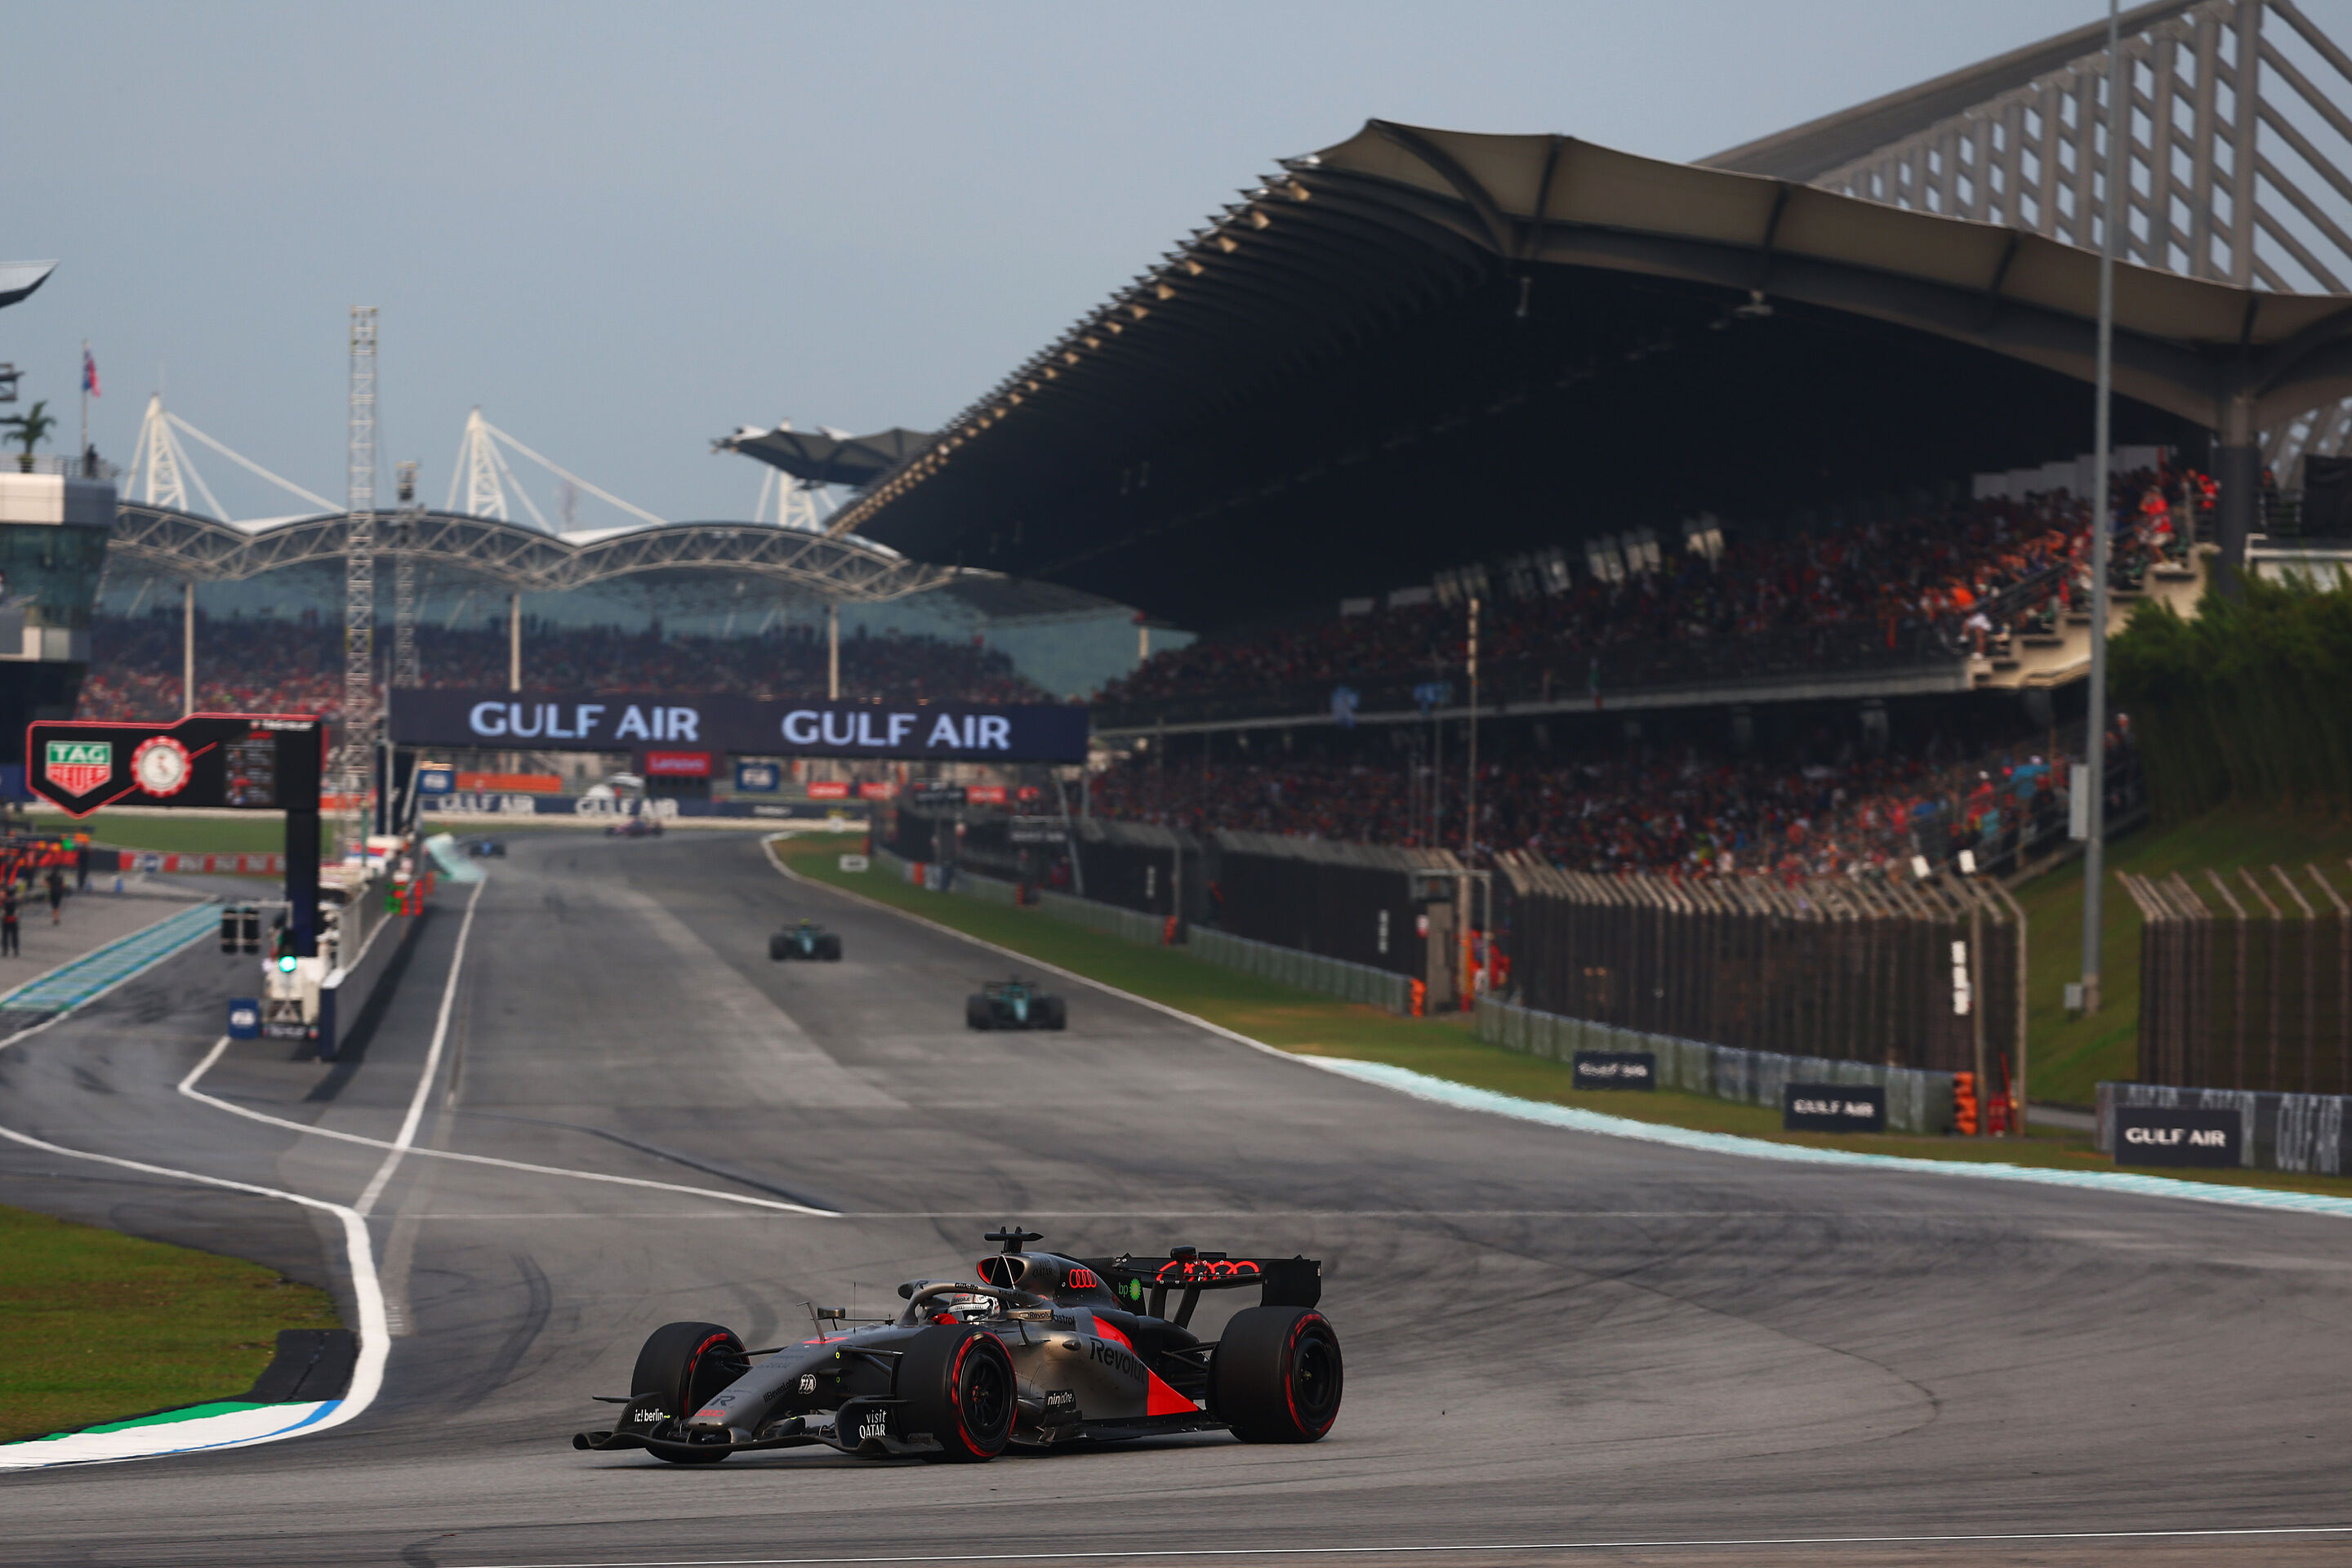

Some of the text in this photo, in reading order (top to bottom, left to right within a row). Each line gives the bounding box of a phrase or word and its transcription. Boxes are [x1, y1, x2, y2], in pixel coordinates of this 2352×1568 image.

[469, 701, 701, 742] GULF AIR
[781, 710, 1012, 751] GULF AIR
[55, 744, 105, 762] TAG
[50, 765, 108, 789] HEUER
[2125, 1127, 2227, 1147] GULF AIR
[954, 1282, 979, 1291] Gillette
[1118, 1282, 1129, 1298] bp
[1053, 1314, 1076, 1325] astrol
[1089, 1337, 1147, 1384] Revolut
[644, 1409, 664, 1423] berlin
[866, 1410, 888, 1424] visit
[859, 1423, 886, 1439] QATAR
